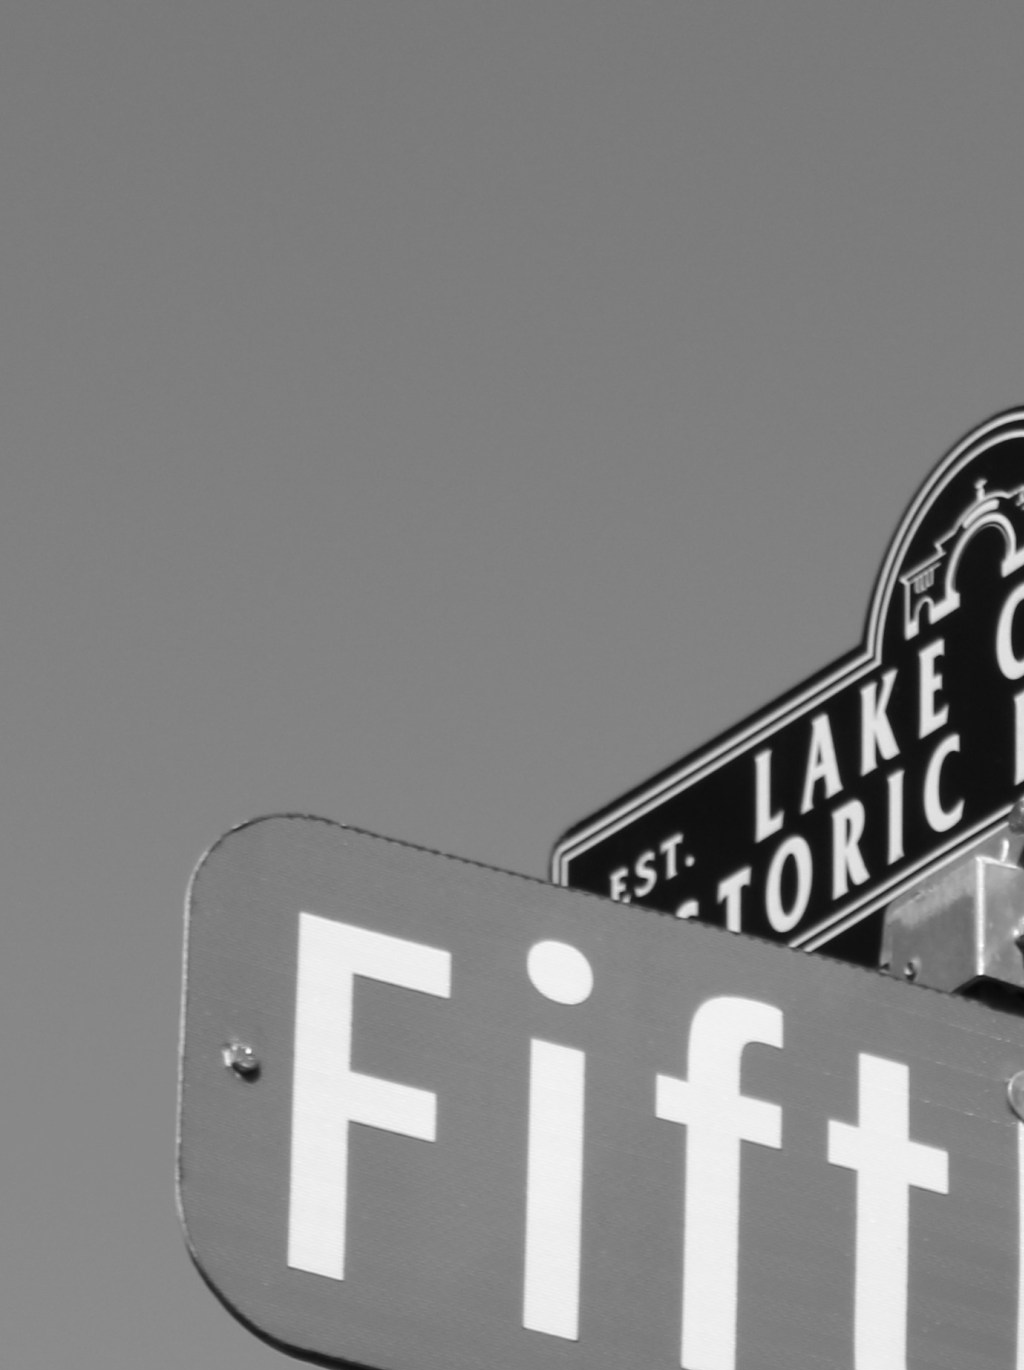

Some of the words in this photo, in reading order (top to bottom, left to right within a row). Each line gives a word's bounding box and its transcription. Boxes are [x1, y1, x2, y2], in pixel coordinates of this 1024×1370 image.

[676, 733, 966, 933] TORIC
[754, 638, 949, 843] LAKE
[610, 832, 695, 904] EST.
